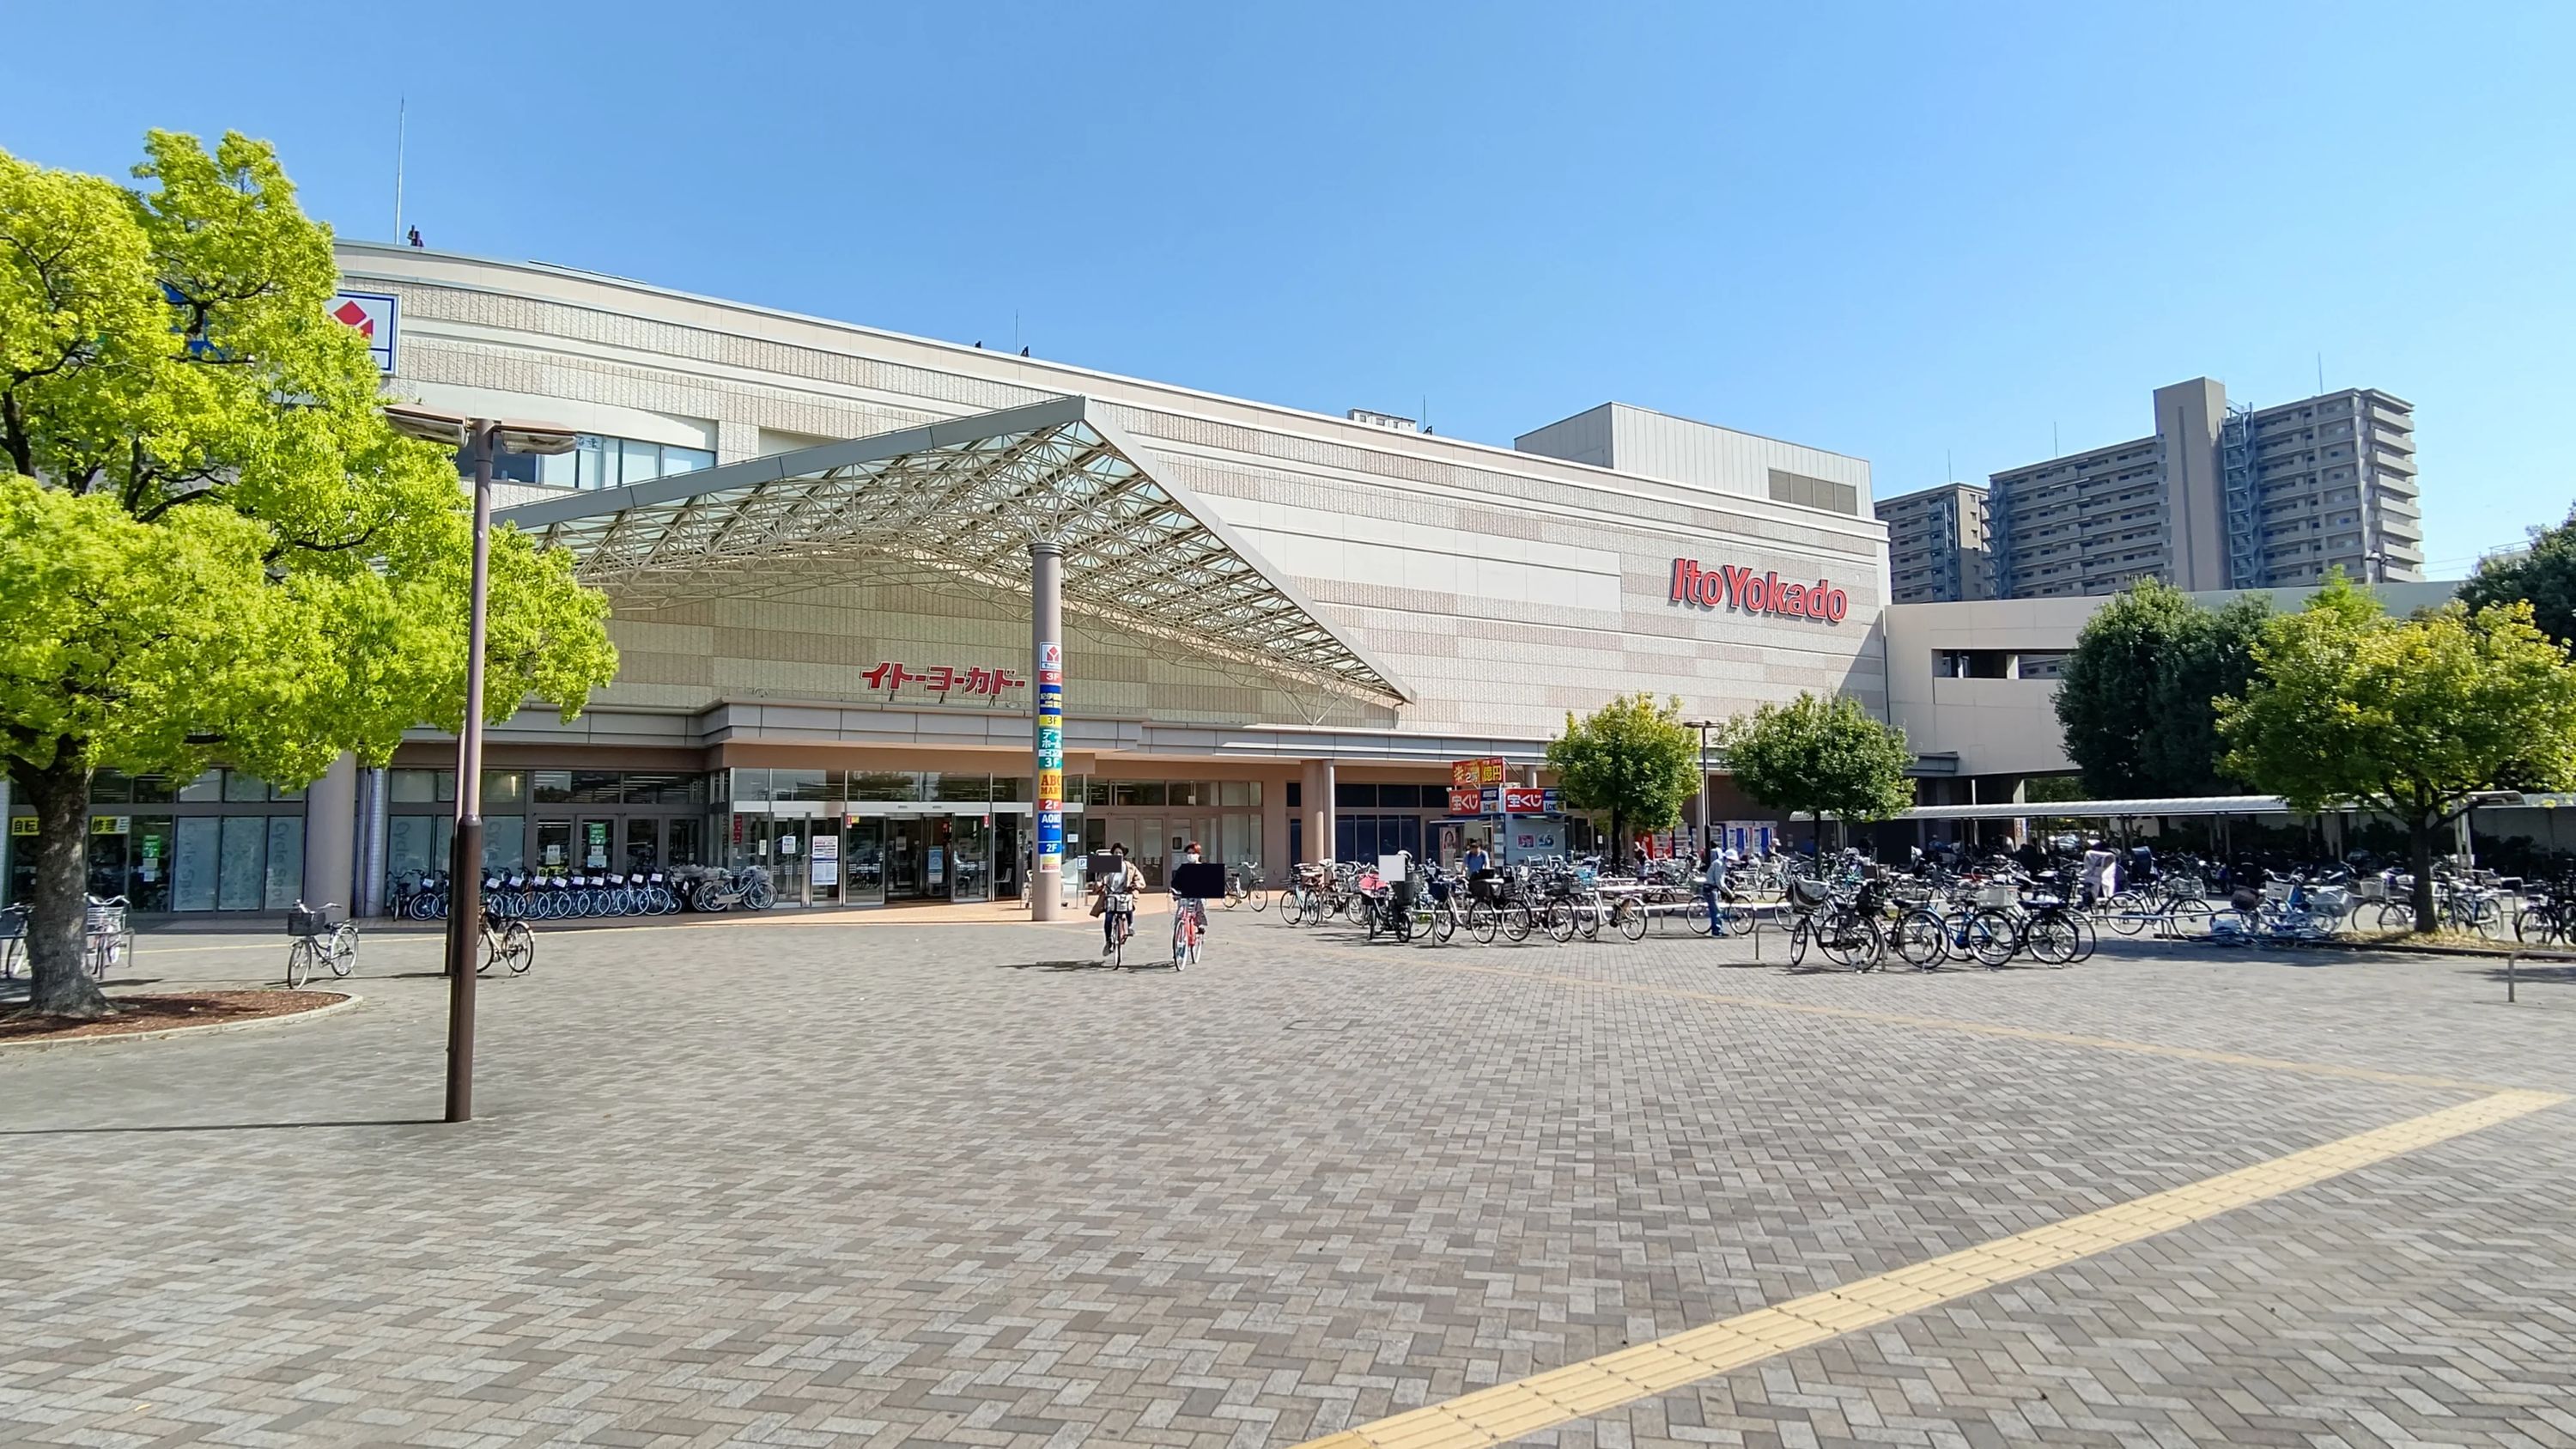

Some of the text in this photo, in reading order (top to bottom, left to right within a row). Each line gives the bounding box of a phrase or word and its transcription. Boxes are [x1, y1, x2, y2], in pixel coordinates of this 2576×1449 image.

[860, 661, 1026, 696] イトーヨーカドー
[1046, 673, 1059, 681] 3F
[1048, 715, 1057, 725] 3F
[1044, 758, 1060, 768] 3F
[1041, 774, 1060, 786] ABC
[1045, 800, 1059, 809] 2F
[1452, 794, 1479, 811] 宝くじ
[1507, 794, 1542, 807] 宝くじ
[14, 819, 40, 832] 自転
[271, 822, 290, 864] Cycle
[392, 822, 411, 862] Cycle
[1046, 843, 1058, 853] 2F
